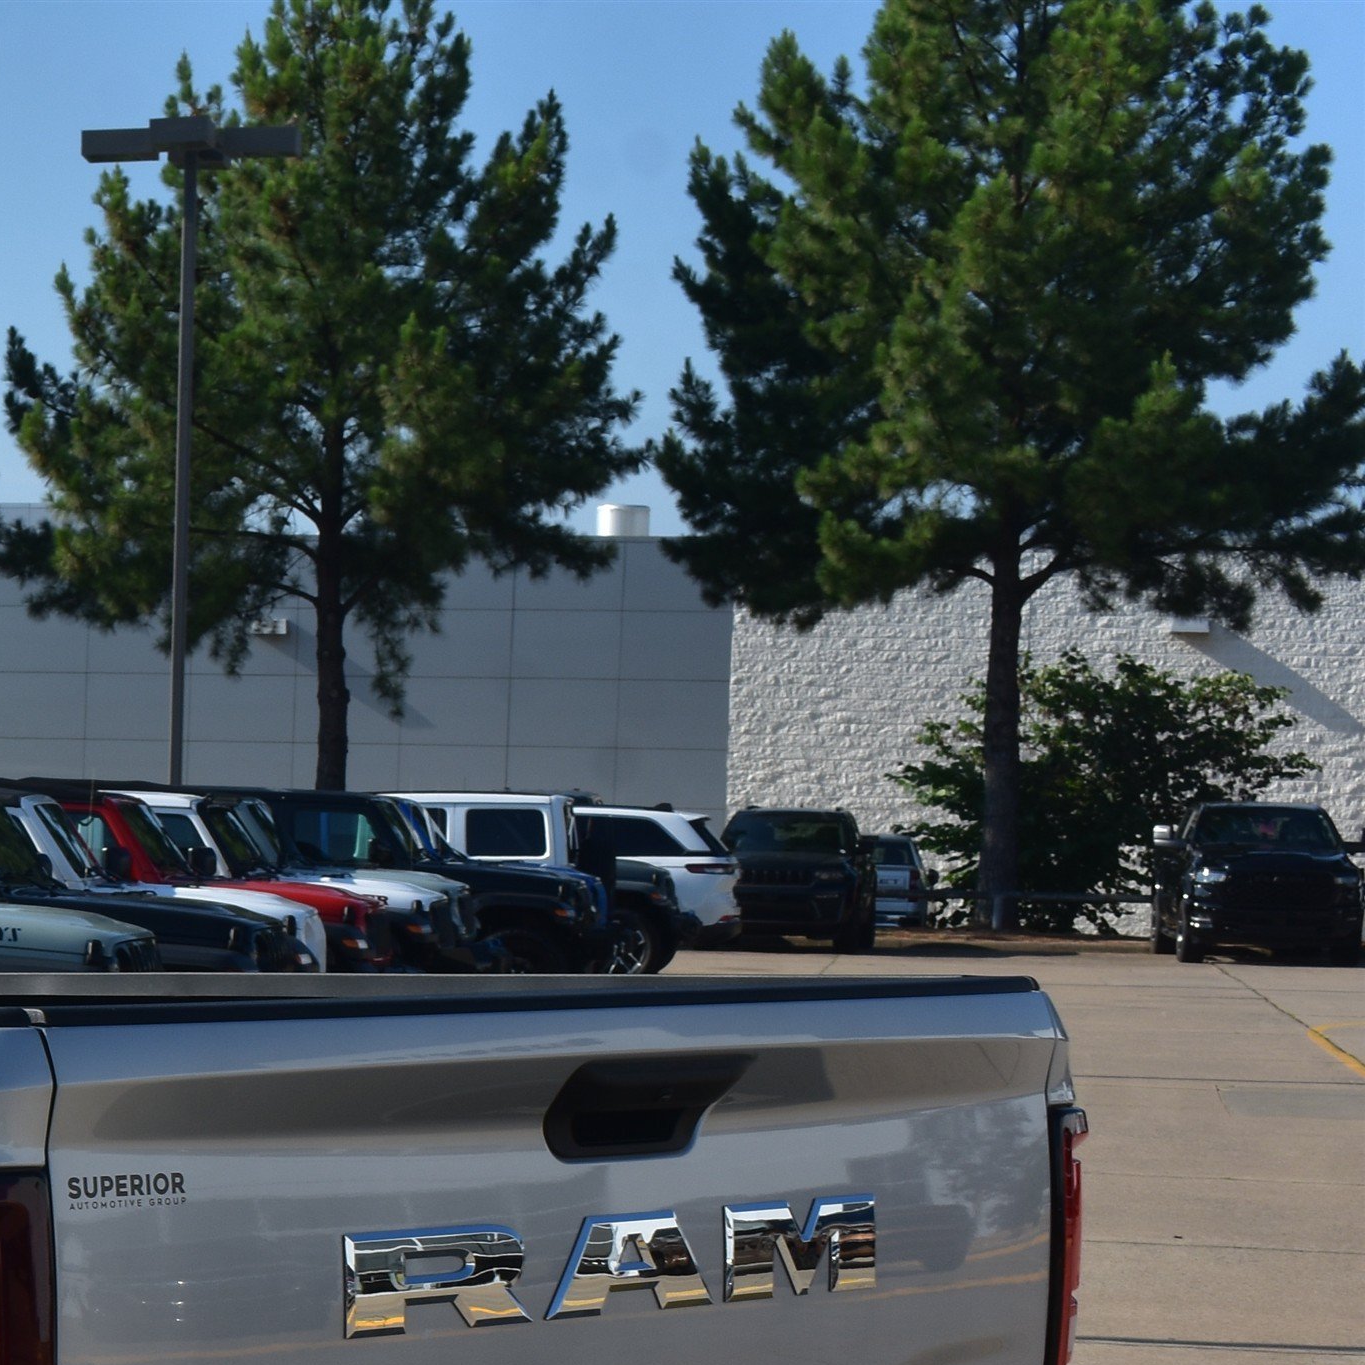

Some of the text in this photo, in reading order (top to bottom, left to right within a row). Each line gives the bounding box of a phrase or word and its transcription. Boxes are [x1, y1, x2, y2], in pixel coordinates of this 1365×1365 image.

[67, 1172, 186, 1199] SUPERIOR
[69, 1196, 187, 1211] AUTOMOTIVE GROUP
[342, 1192, 877, 1340] RAM
